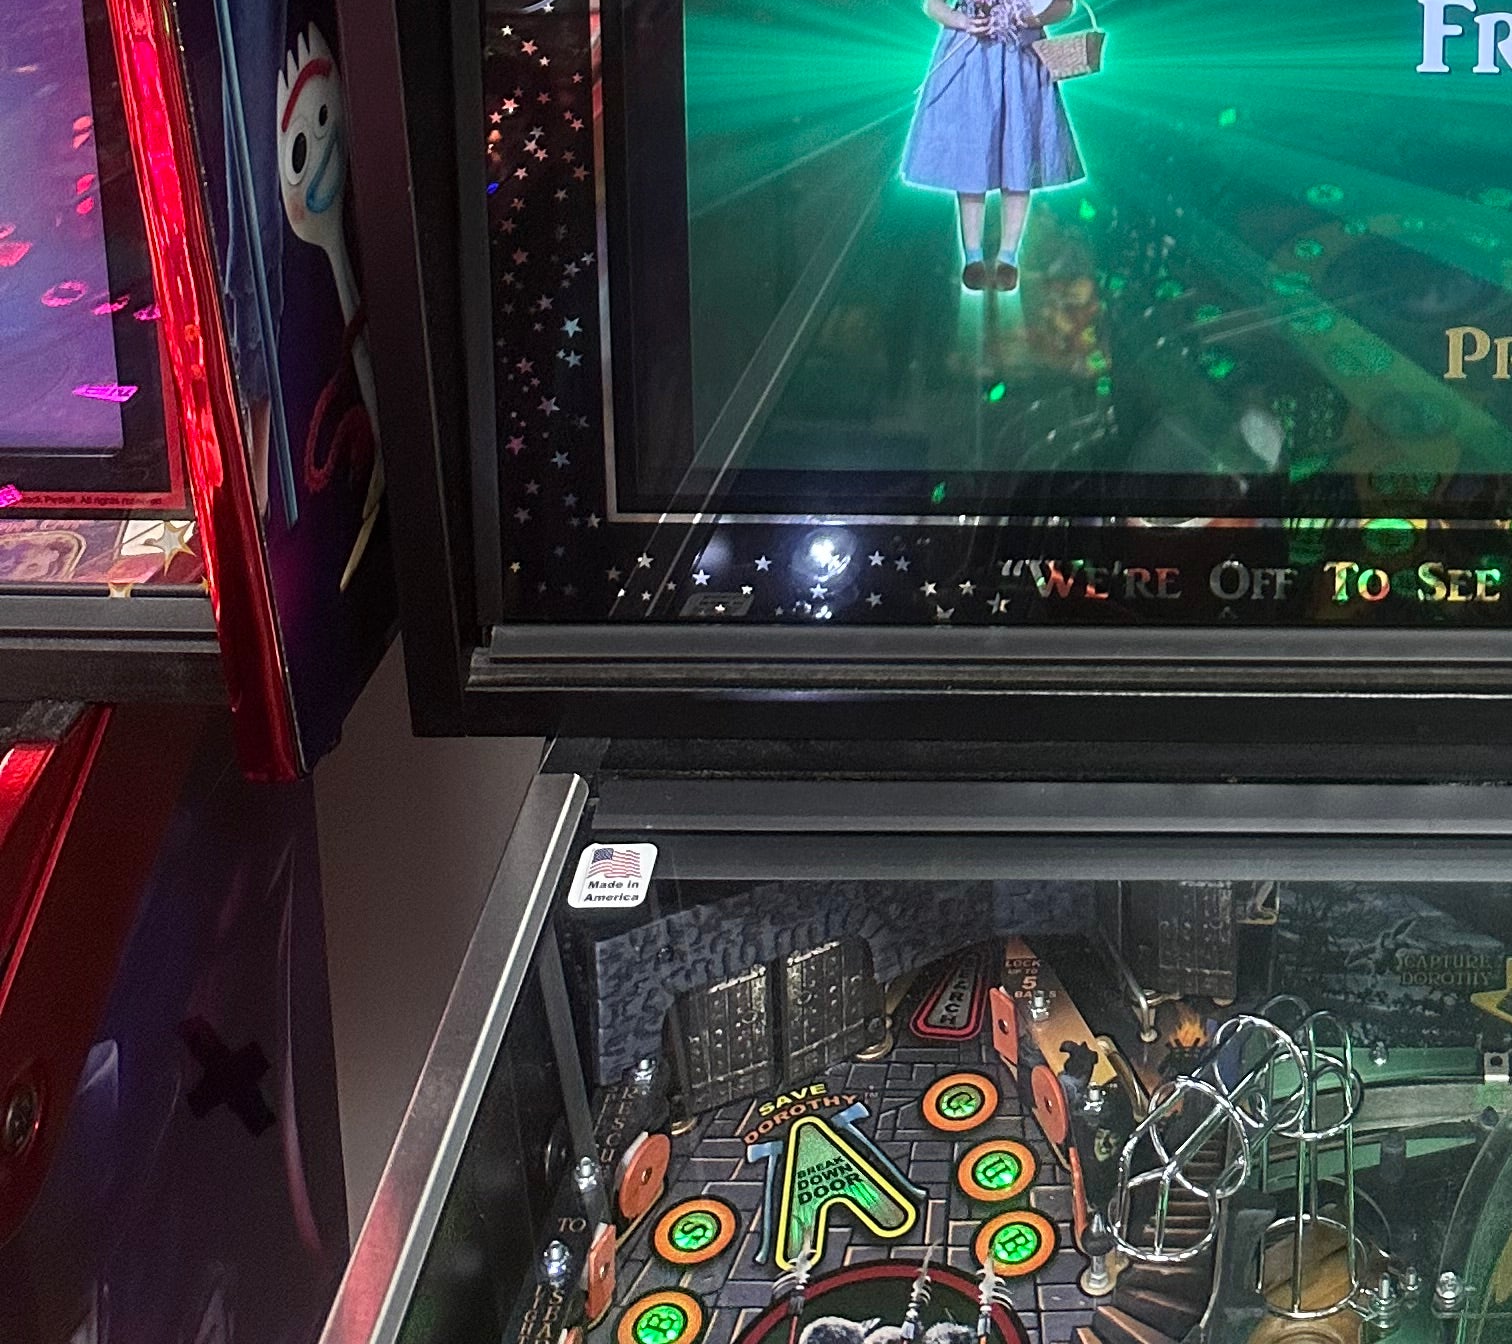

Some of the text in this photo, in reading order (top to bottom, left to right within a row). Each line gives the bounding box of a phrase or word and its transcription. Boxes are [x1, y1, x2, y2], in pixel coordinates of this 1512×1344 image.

[587, 879, 640, 890] Made in
[583, 891, 640, 902] America
[1004, 958, 1042, 968] LOCK
[1021, 975, 1038, 990] 5
[1401, 971, 1490, 986] DOROTHY
[1014, 990, 1057, 999] BAS
[758, 1083, 828, 1117] SAVE
[743, 1093, 860, 1145] DOROTHY
[797, 1154, 846, 1180] BREAK
[797, 1162, 854, 1191] DOWN
[798, 1171, 864, 1206] DOOR
[558, 1216, 587, 1234] TO
